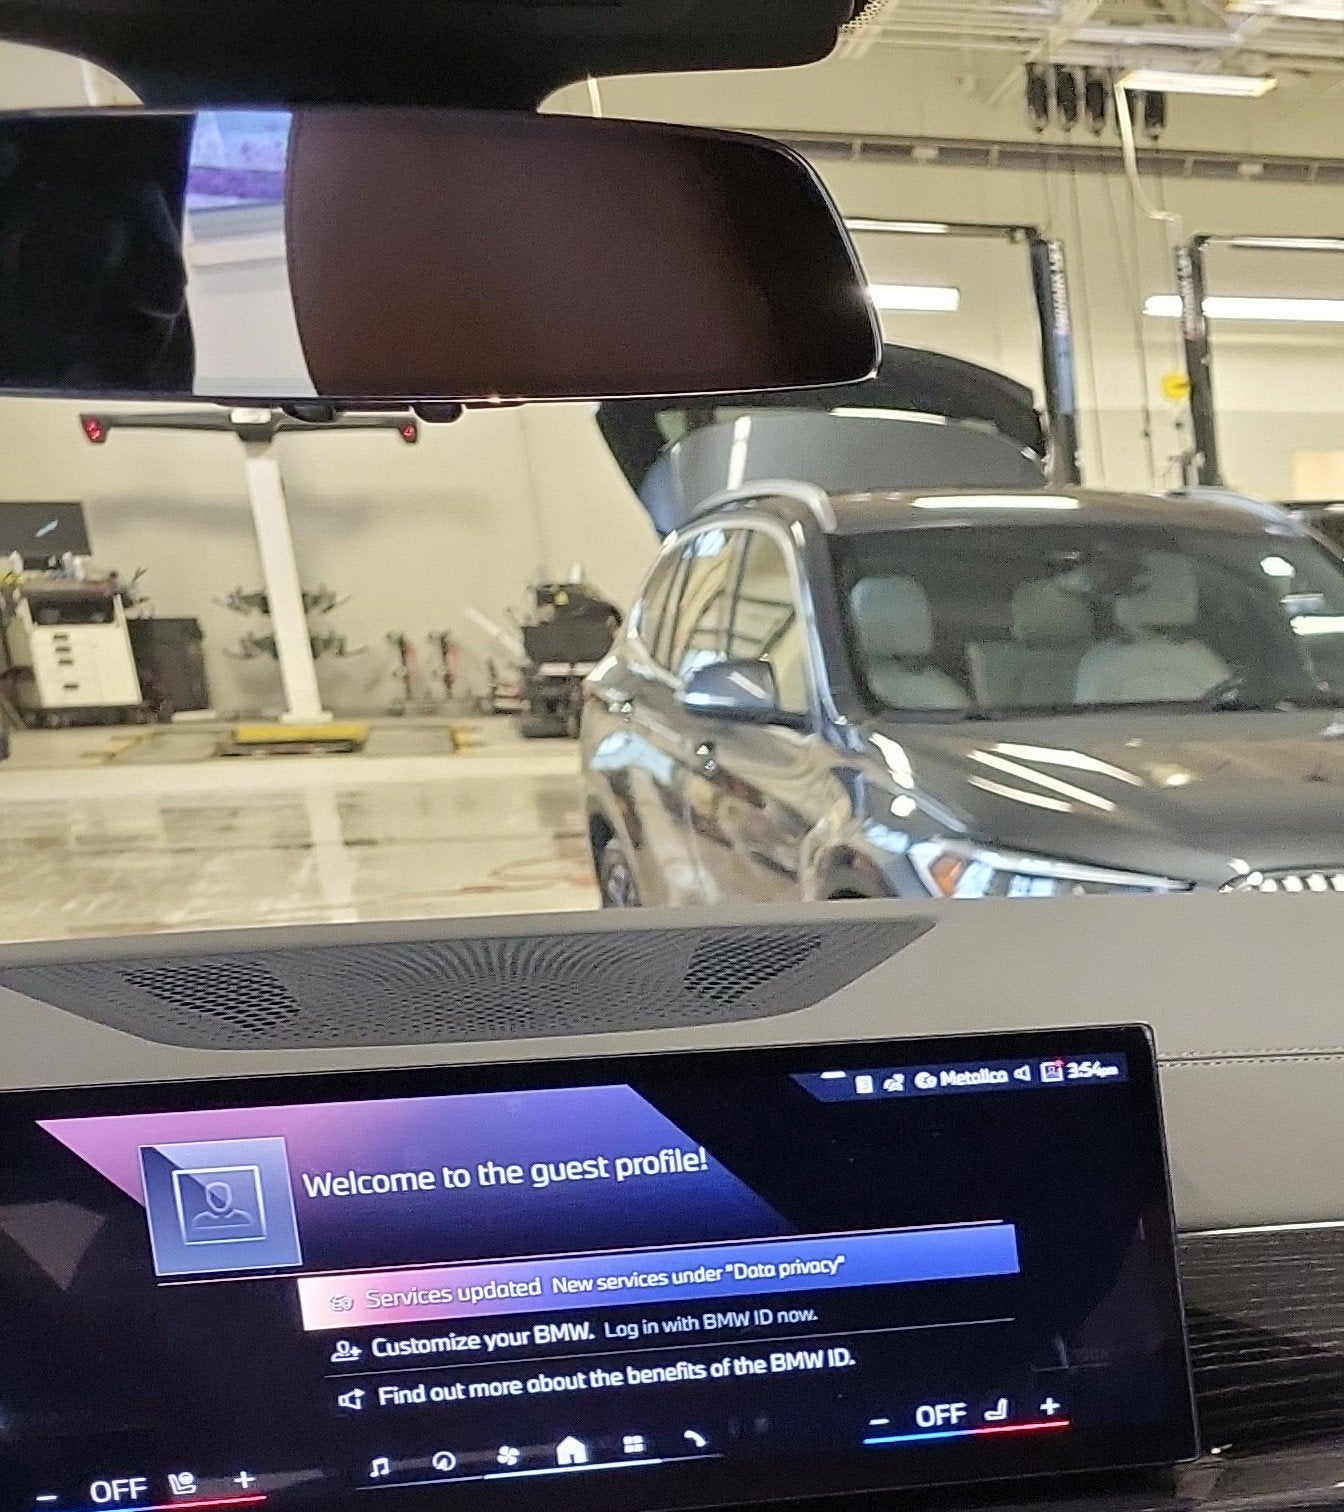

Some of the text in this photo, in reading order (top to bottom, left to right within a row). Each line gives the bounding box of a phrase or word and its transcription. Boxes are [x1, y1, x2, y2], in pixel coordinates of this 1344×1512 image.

[302, 1146, 709, 1198] Welcome to the guest profile!
[365, 1255, 845, 1310] Services updated New services under "Data privacy"
[371, 1308, 818, 1357] Customize your BMW. Log in with BMW ID now.
[378, 1348, 856, 1406] Find out more about the benefits of the BMW ID.
[916, 1402, 968, 1427] OFF
[90, 1477, 149, 1503] OFF
